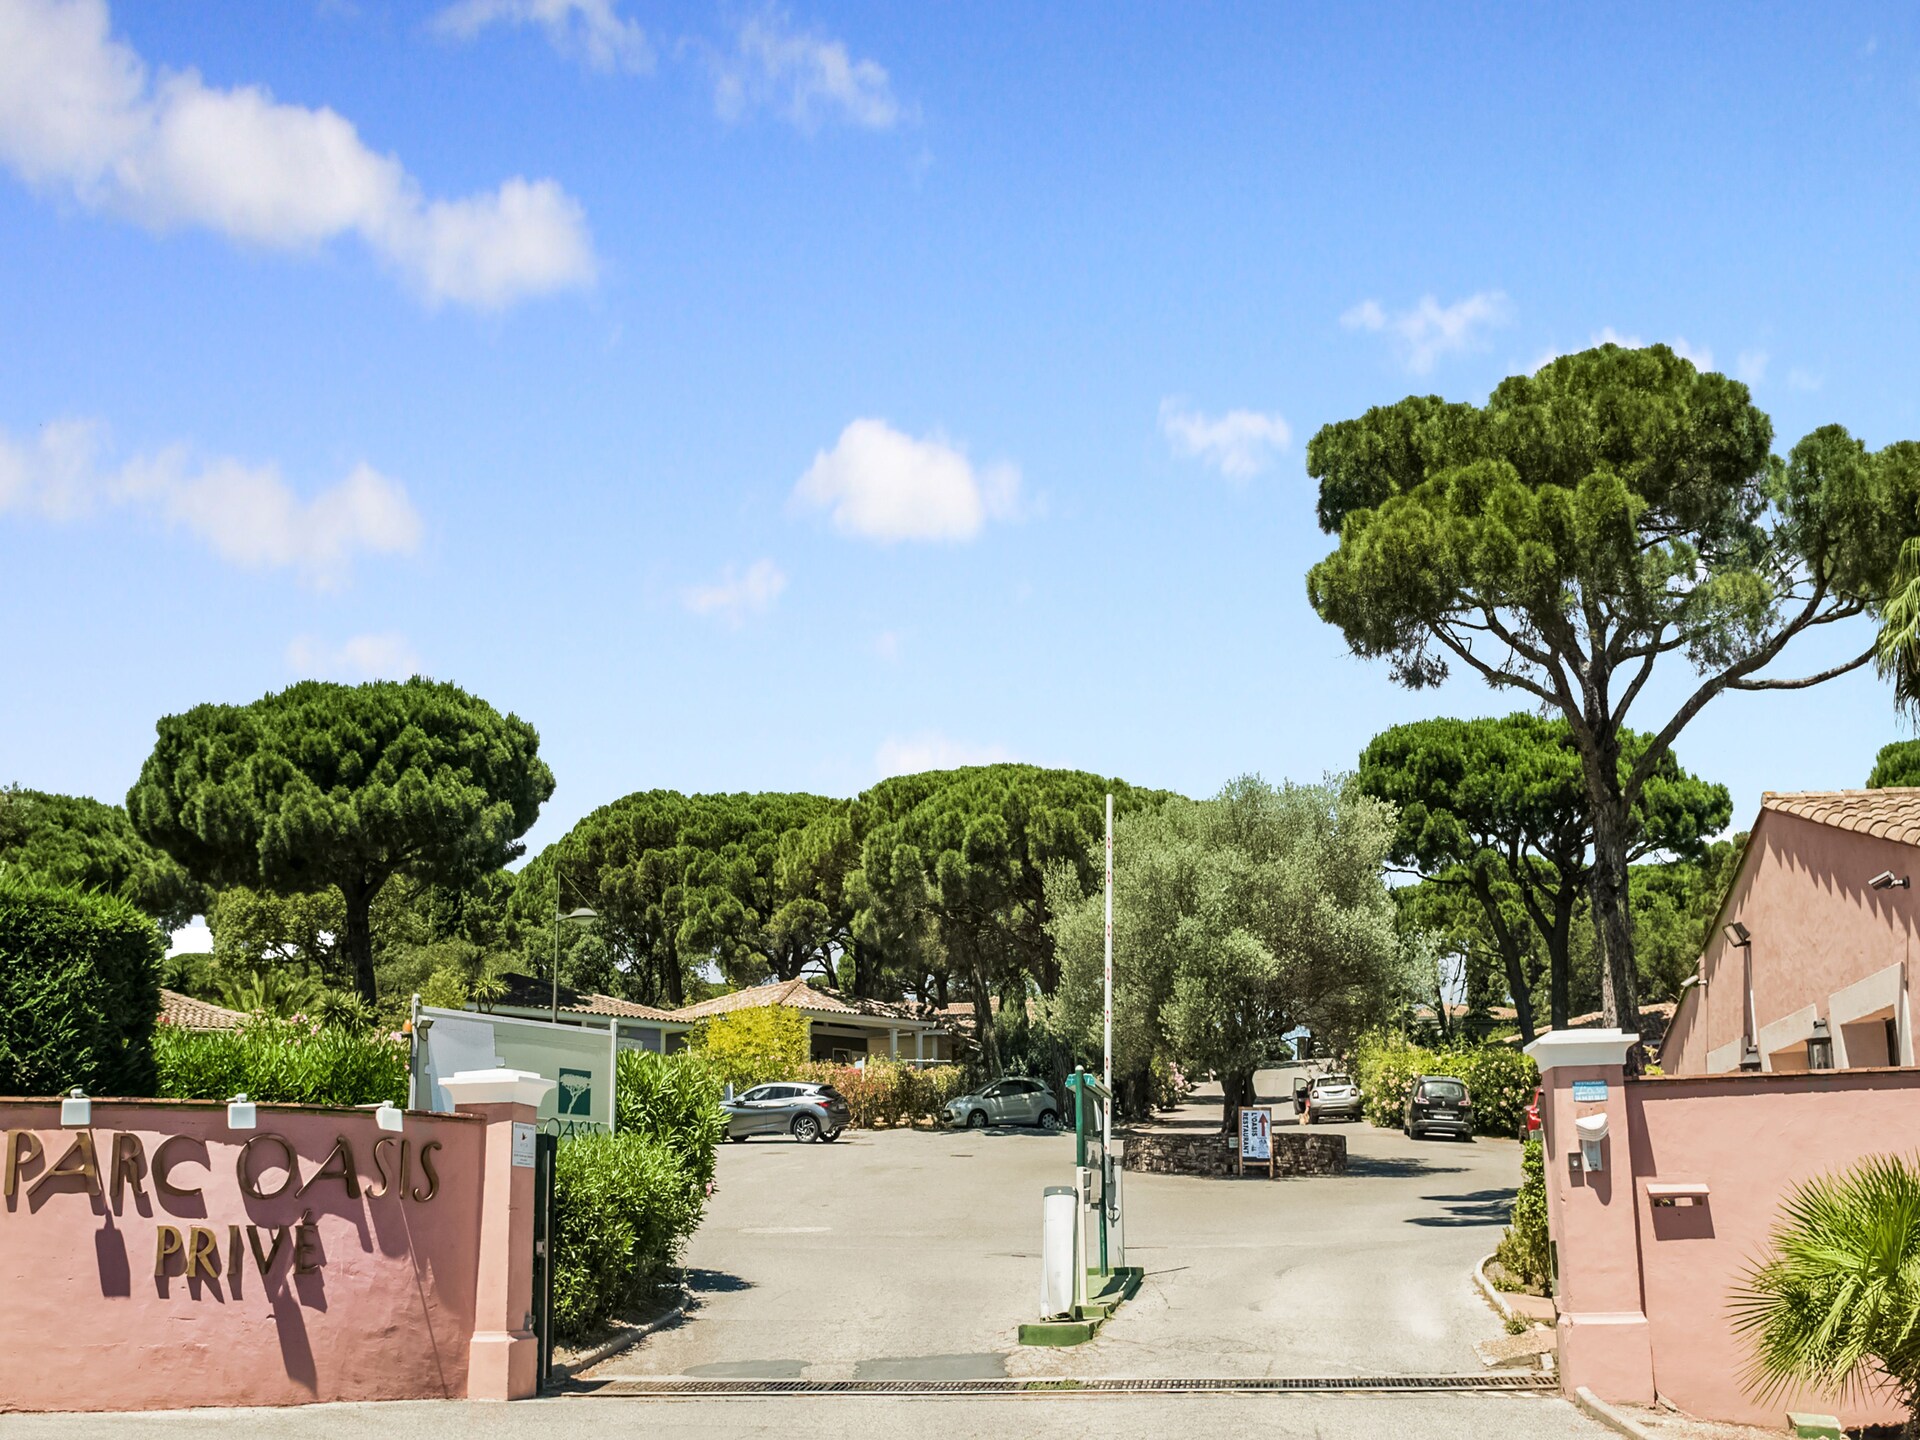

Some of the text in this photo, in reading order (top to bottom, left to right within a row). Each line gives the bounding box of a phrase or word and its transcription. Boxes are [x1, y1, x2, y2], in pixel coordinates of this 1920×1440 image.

[4, 1129, 443, 1203] PARC OASIS
[154, 1208, 319, 1279] PRIVÉ
